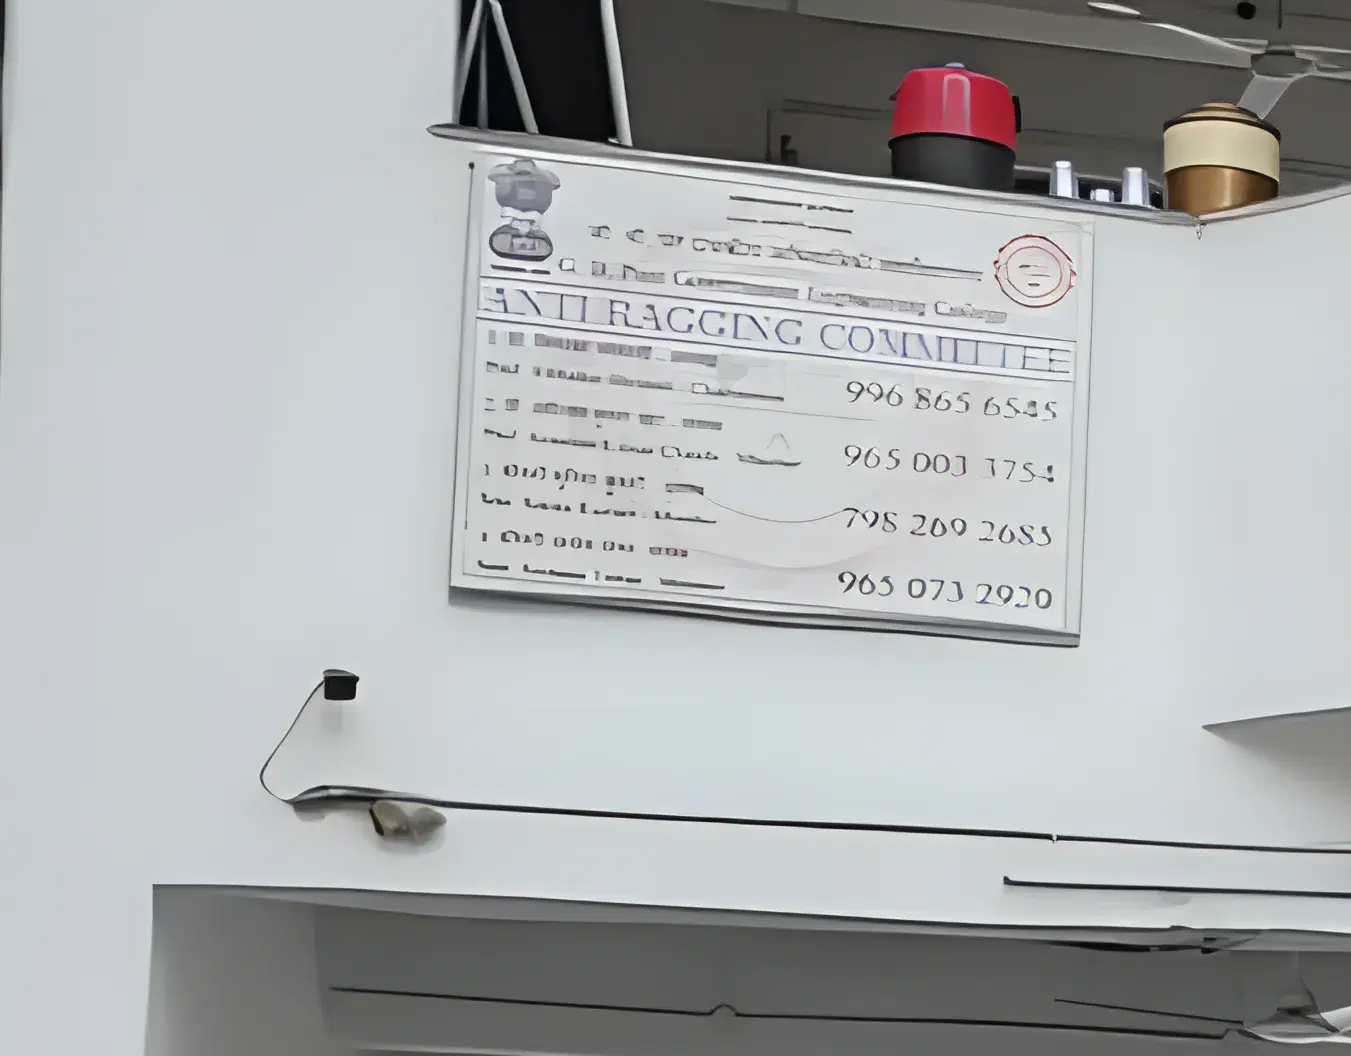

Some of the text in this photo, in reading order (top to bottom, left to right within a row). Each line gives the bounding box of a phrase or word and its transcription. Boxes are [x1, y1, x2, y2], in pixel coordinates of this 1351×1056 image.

[483, 287, 588, 323] ANTI
[609, 299, 802, 346] RAGGING
[819, 323, 1071, 374] COMMITTEE
